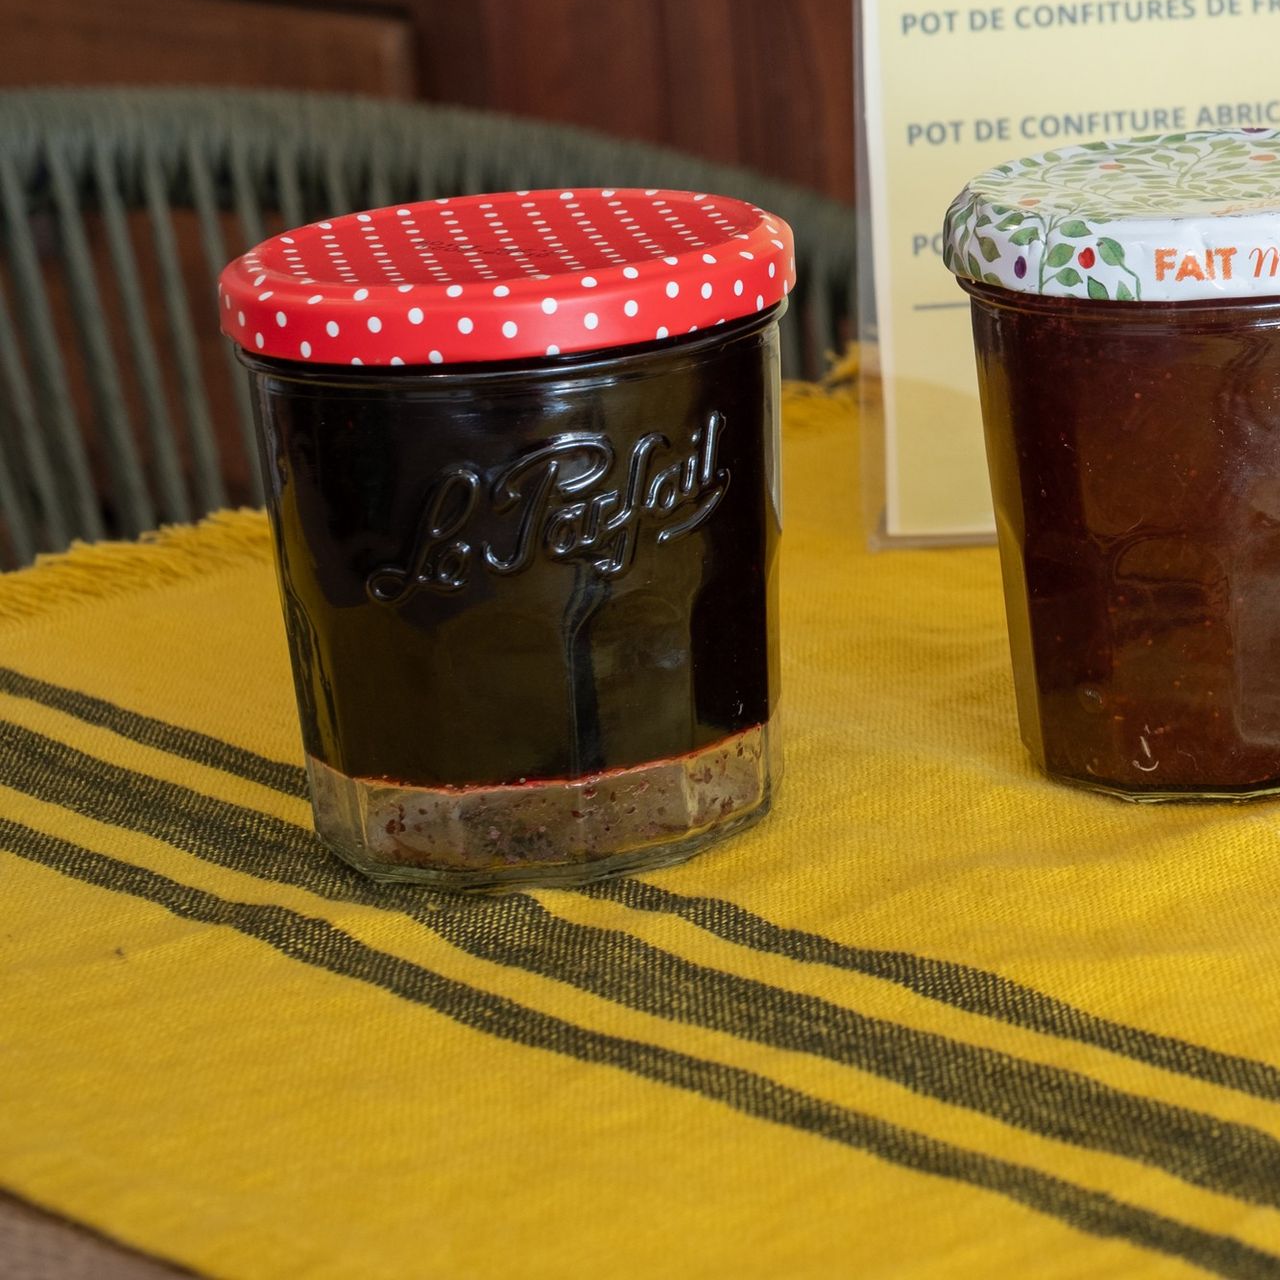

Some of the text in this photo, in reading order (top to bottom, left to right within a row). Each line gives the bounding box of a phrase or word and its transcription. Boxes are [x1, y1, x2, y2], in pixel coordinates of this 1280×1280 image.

[901, 10, 958, 35] POT
[969, 8, 1004, 32] DE
[907, 121, 963, 146] POT
[974, 118, 1010, 142] DE
[1020, 106, 1187, 139] CONFITURE
[1154, 246, 1237, 282] FAIT
